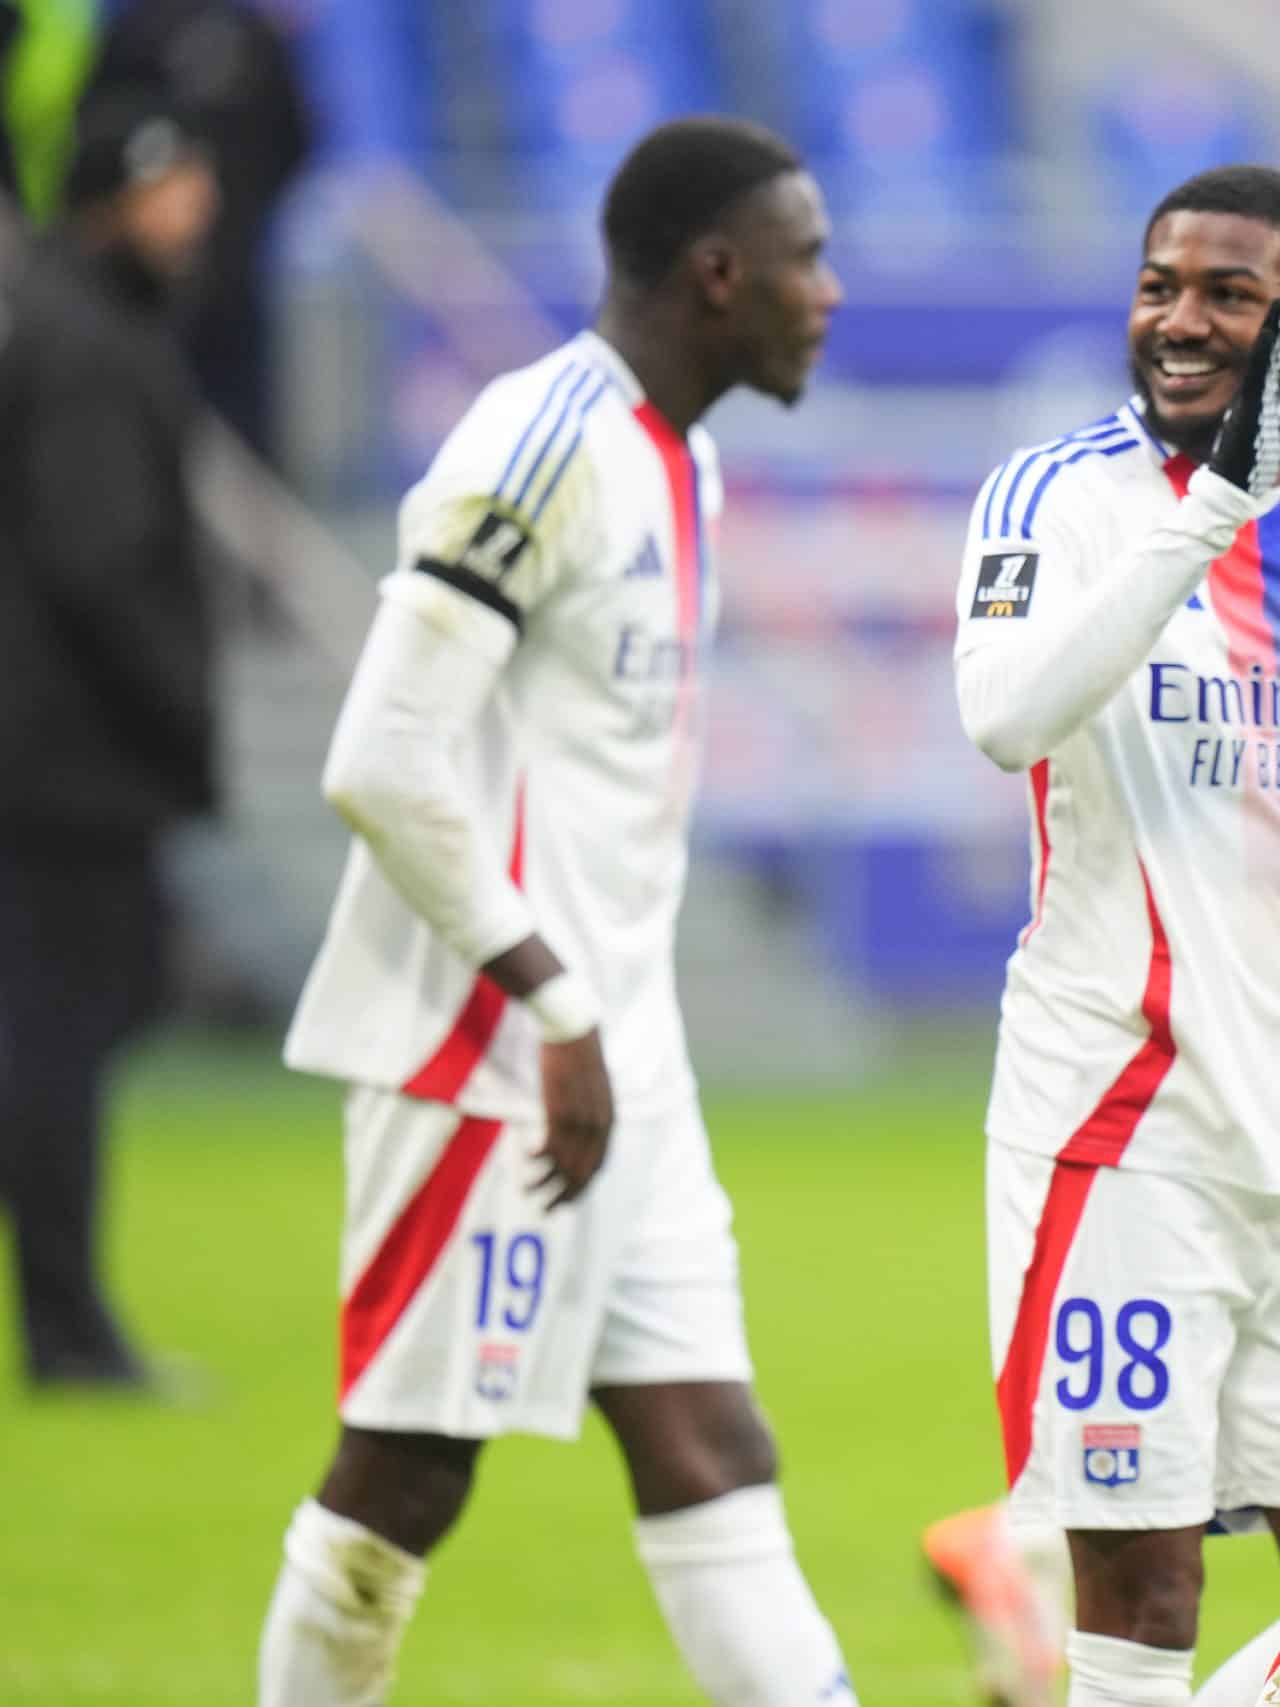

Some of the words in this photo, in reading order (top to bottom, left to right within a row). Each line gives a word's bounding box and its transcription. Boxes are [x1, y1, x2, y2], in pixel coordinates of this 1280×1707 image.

[1189, 738, 1246, 788] FLY
[472, 1233, 545, 1330] 19
[1056, 1297, 1172, 1411] 98
[1087, 1450, 1137, 1480] OL
